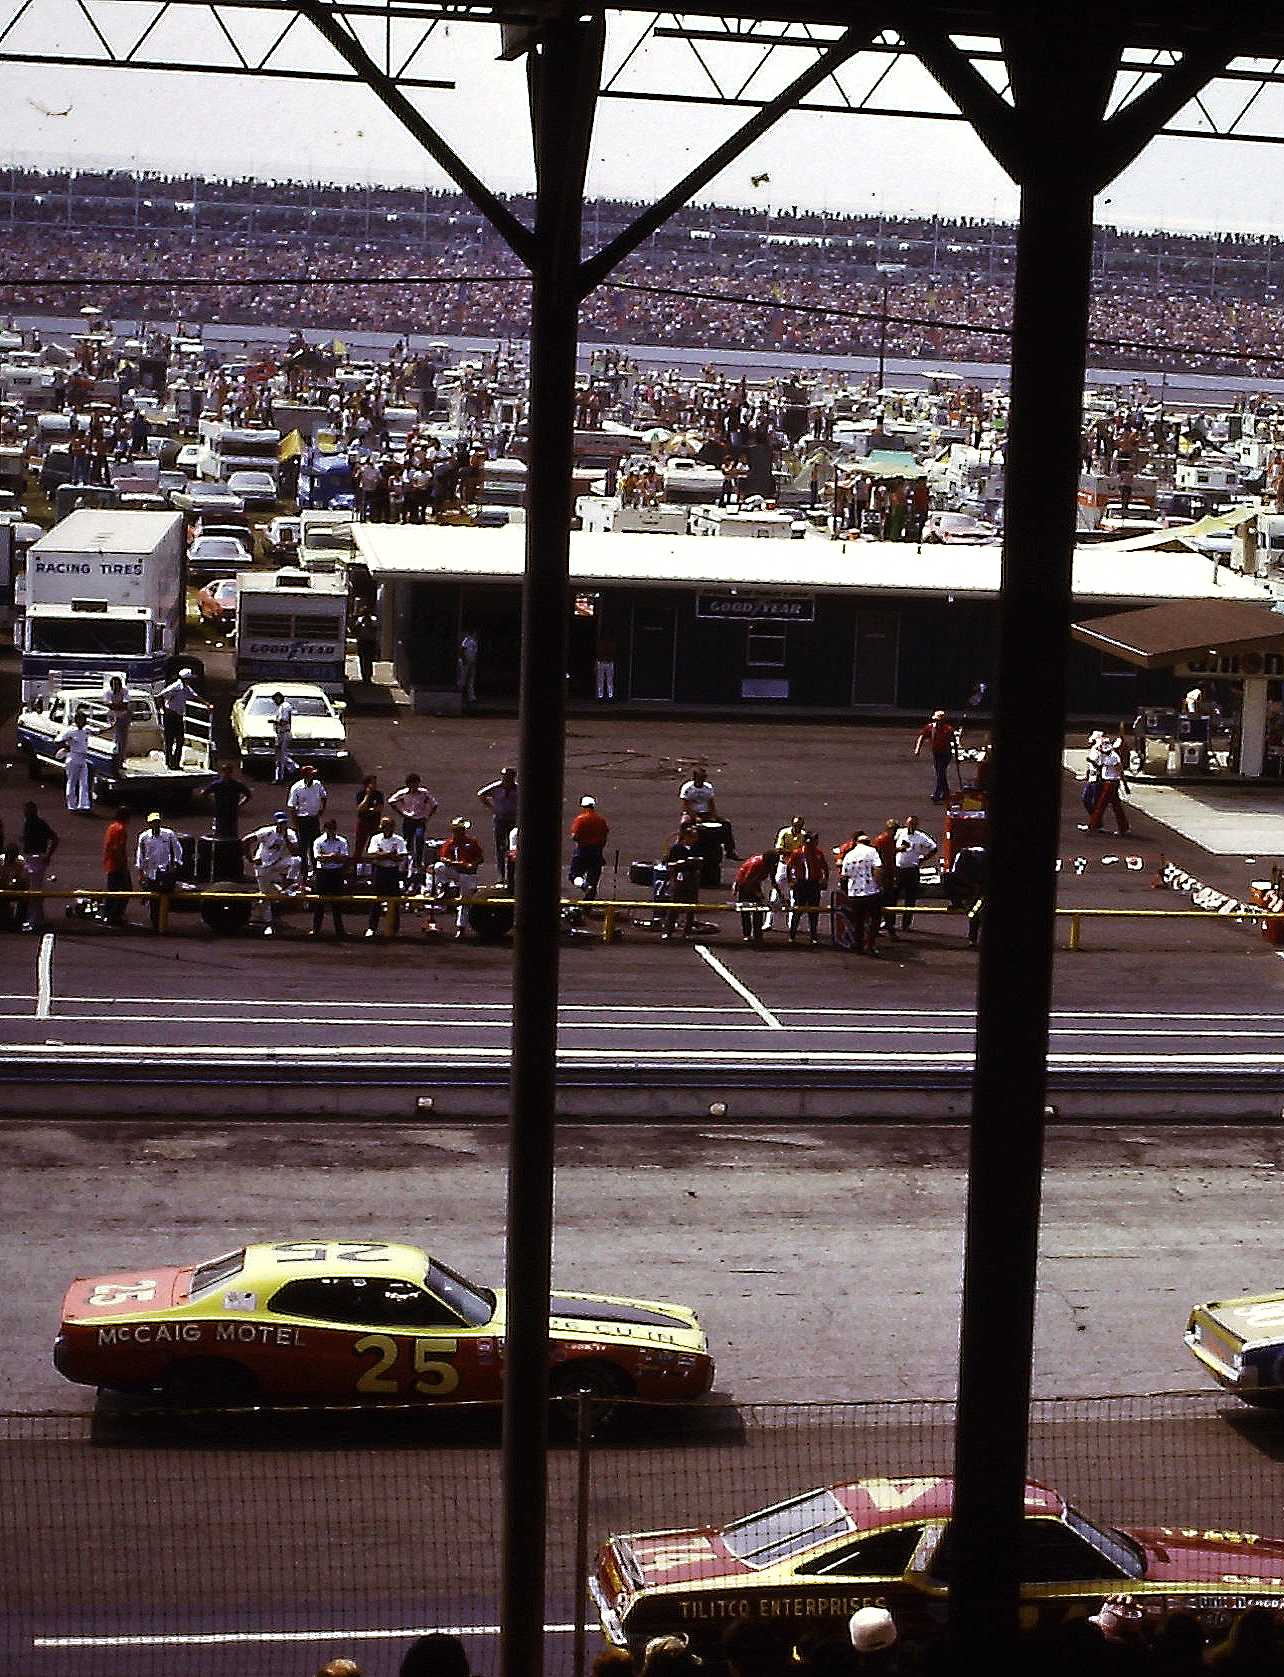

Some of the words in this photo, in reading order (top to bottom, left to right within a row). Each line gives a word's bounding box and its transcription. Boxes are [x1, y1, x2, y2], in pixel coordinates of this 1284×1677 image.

[36, 562, 91, 574] RACING
[101, 563, 143, 576] TIRES
[88, 1279, 157, 1306] 25
[216, 1324, 306, 1347] MOTEL
[355, 1334, 459, 1393] 25
